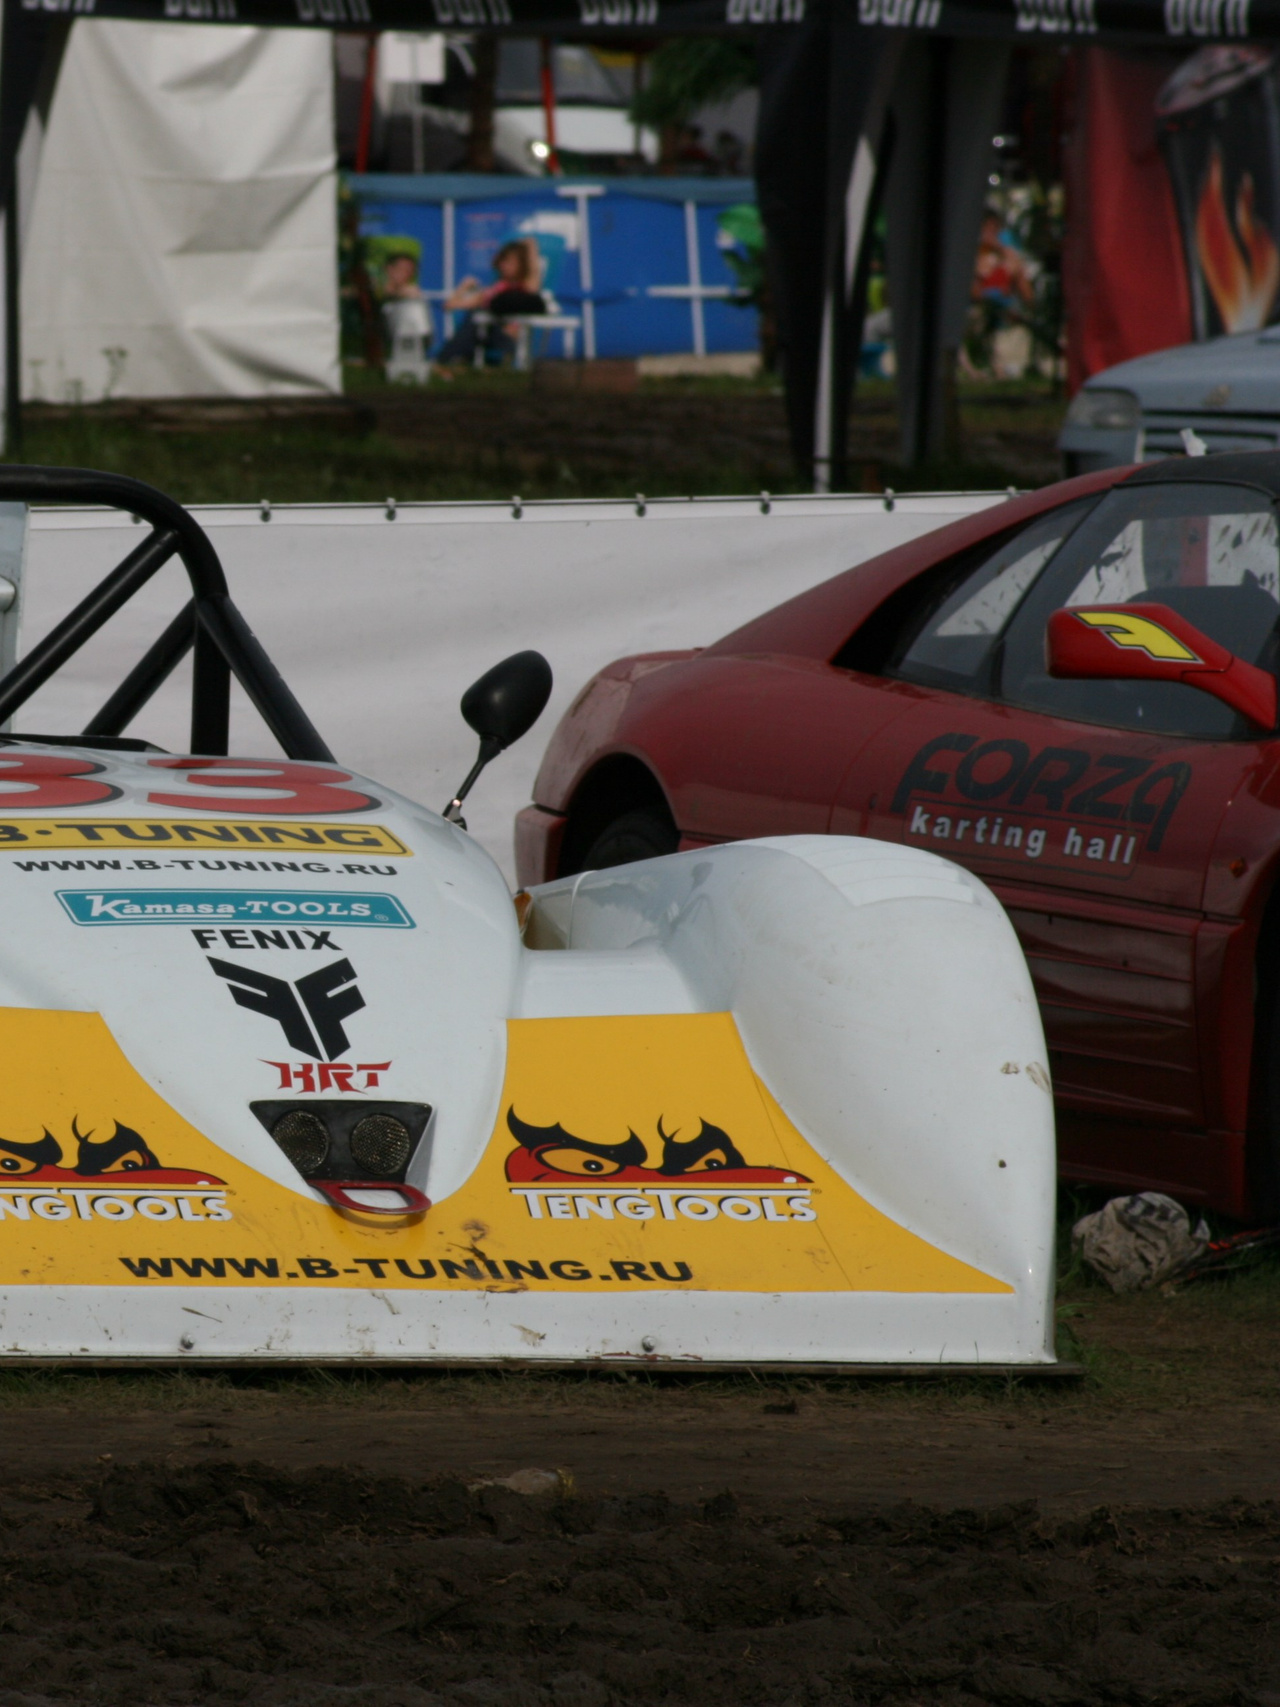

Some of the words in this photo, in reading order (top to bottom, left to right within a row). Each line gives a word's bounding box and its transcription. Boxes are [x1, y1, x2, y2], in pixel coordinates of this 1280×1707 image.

[909, 805, 1048, 859] karting
[1063, 826, 1138, 865] hall
[13, 860, 398, 877] WWW.B-TUNING.RU
[84, 894, 372, 920] Kamasa-TOOLS
[190, 928, 344, 951] FENIX
[118, 1256, 695, 1283] WWW.B-TUNING.RU
